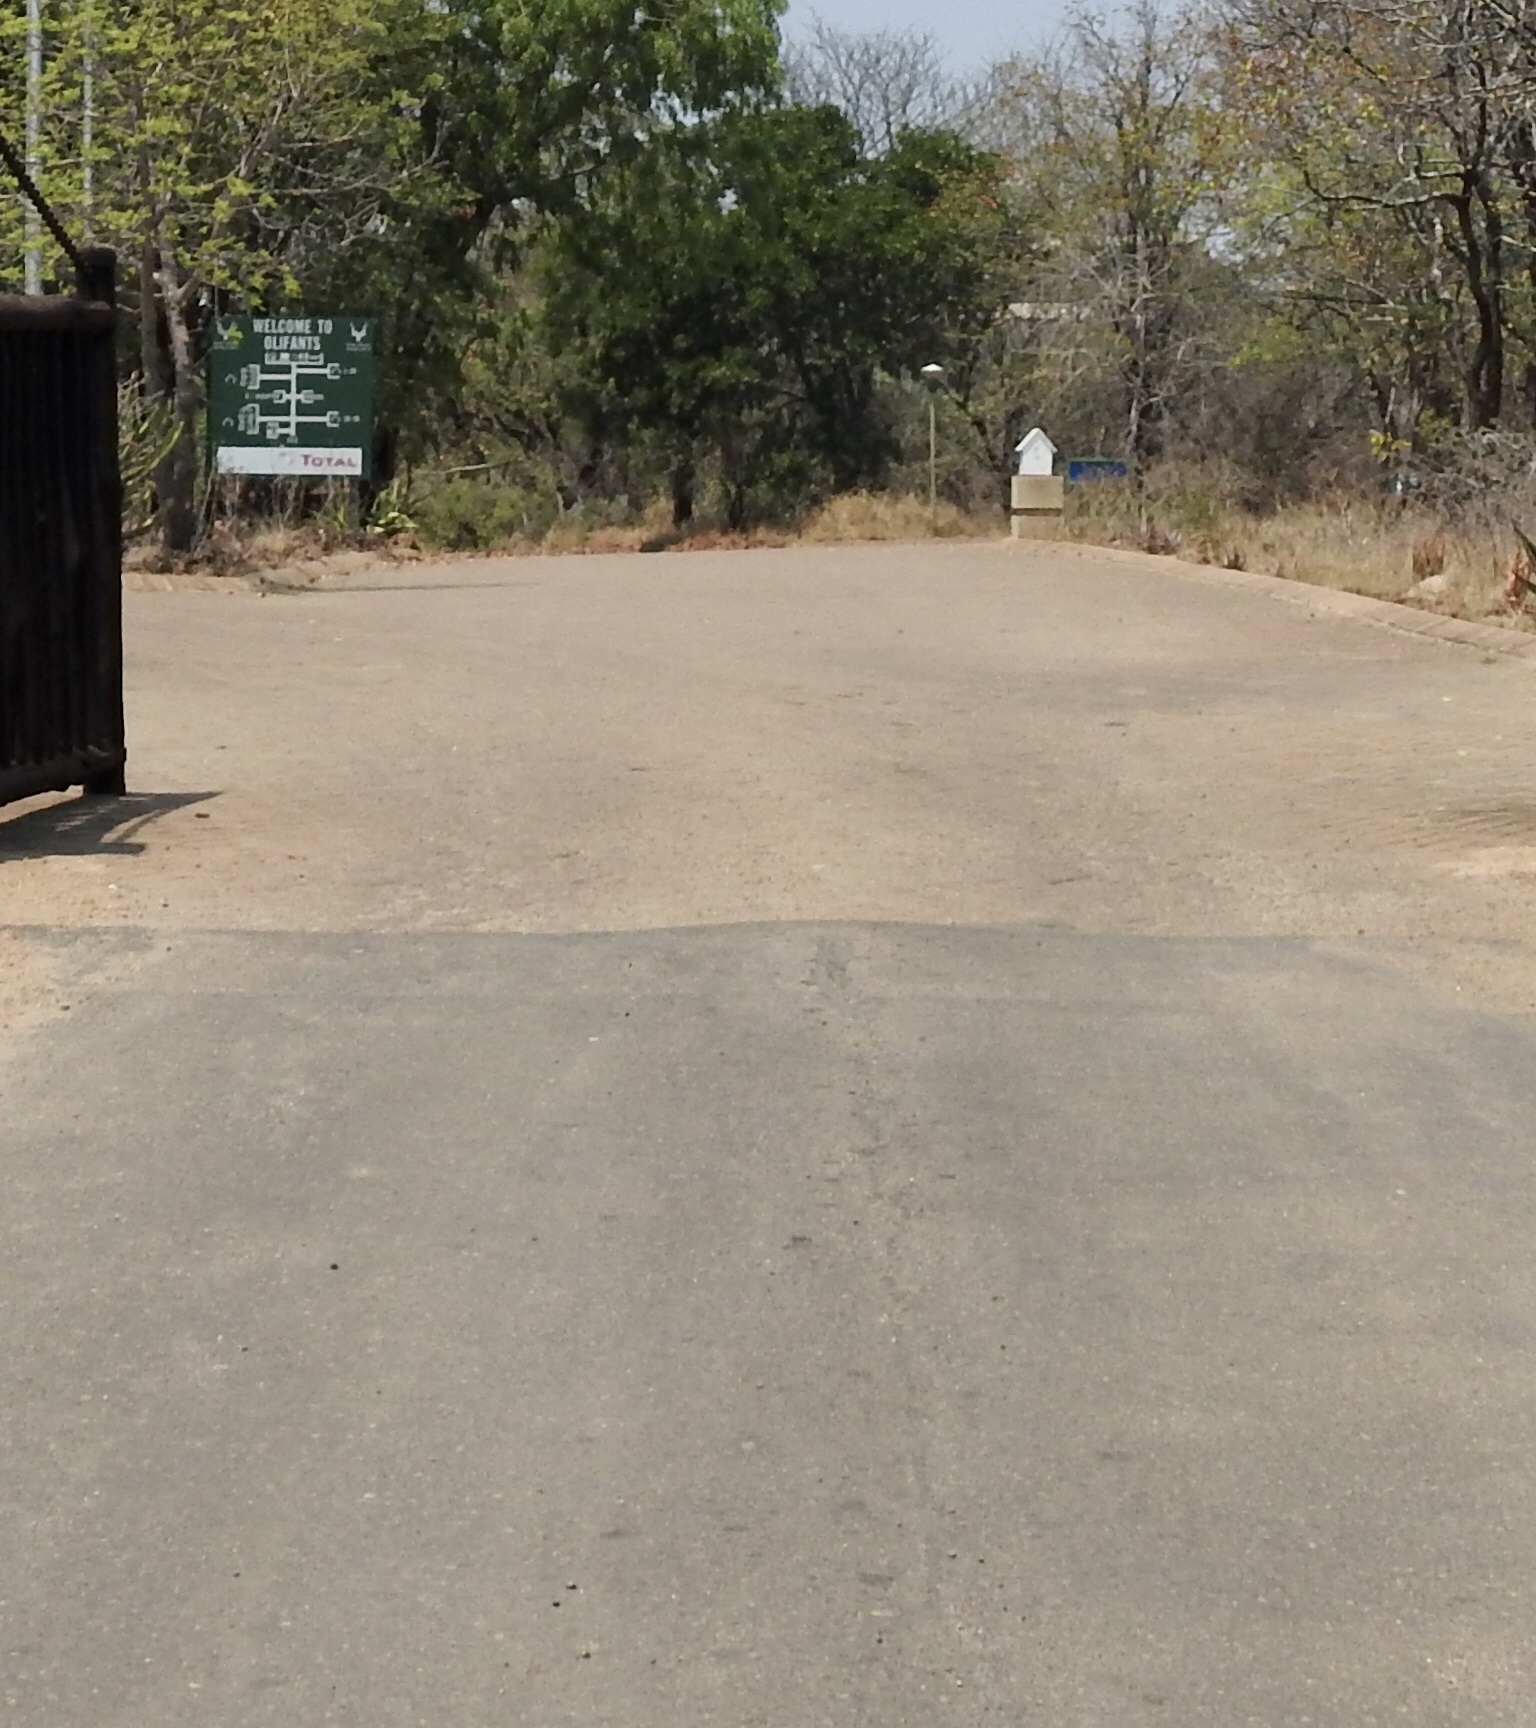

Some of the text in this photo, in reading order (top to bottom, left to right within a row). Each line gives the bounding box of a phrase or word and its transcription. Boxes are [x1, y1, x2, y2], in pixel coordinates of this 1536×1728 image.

[252, 319, 333, 334] WELCOME TO
[264, 335, 321, 351] OLIFANTS
[301, 454, 356, 467] TOTAL
